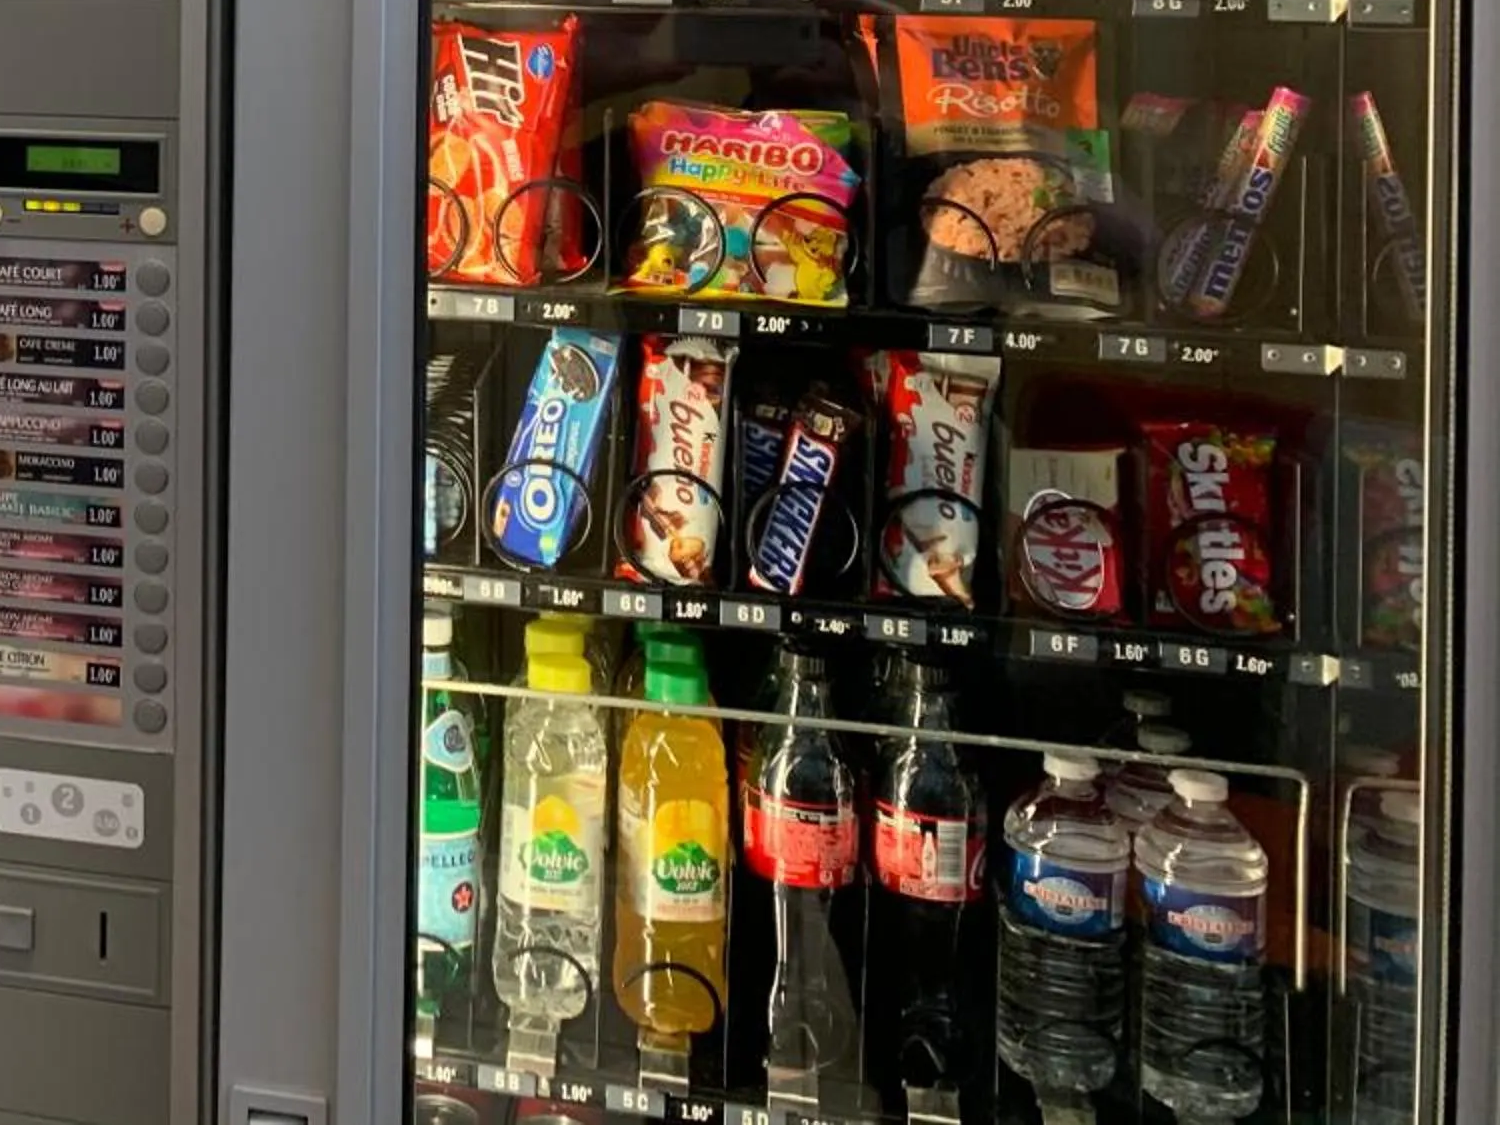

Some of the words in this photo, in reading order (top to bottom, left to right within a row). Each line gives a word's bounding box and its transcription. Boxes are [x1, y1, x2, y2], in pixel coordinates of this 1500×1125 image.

[926, 82, 1061, 119] Risotto
[660, 129, 825, 176] HARIBO
[669, 157, 747, 187] Happy
[23, 266, 62, 281] COURT
[19, 305, 53, 319] LONG
[7, 377, 37, 392] LONG
[523, 398, 565, 522] OREO
[1177, 442, 1247, 614] Skitles
[1025, 499, 1102, 595] KitKa
